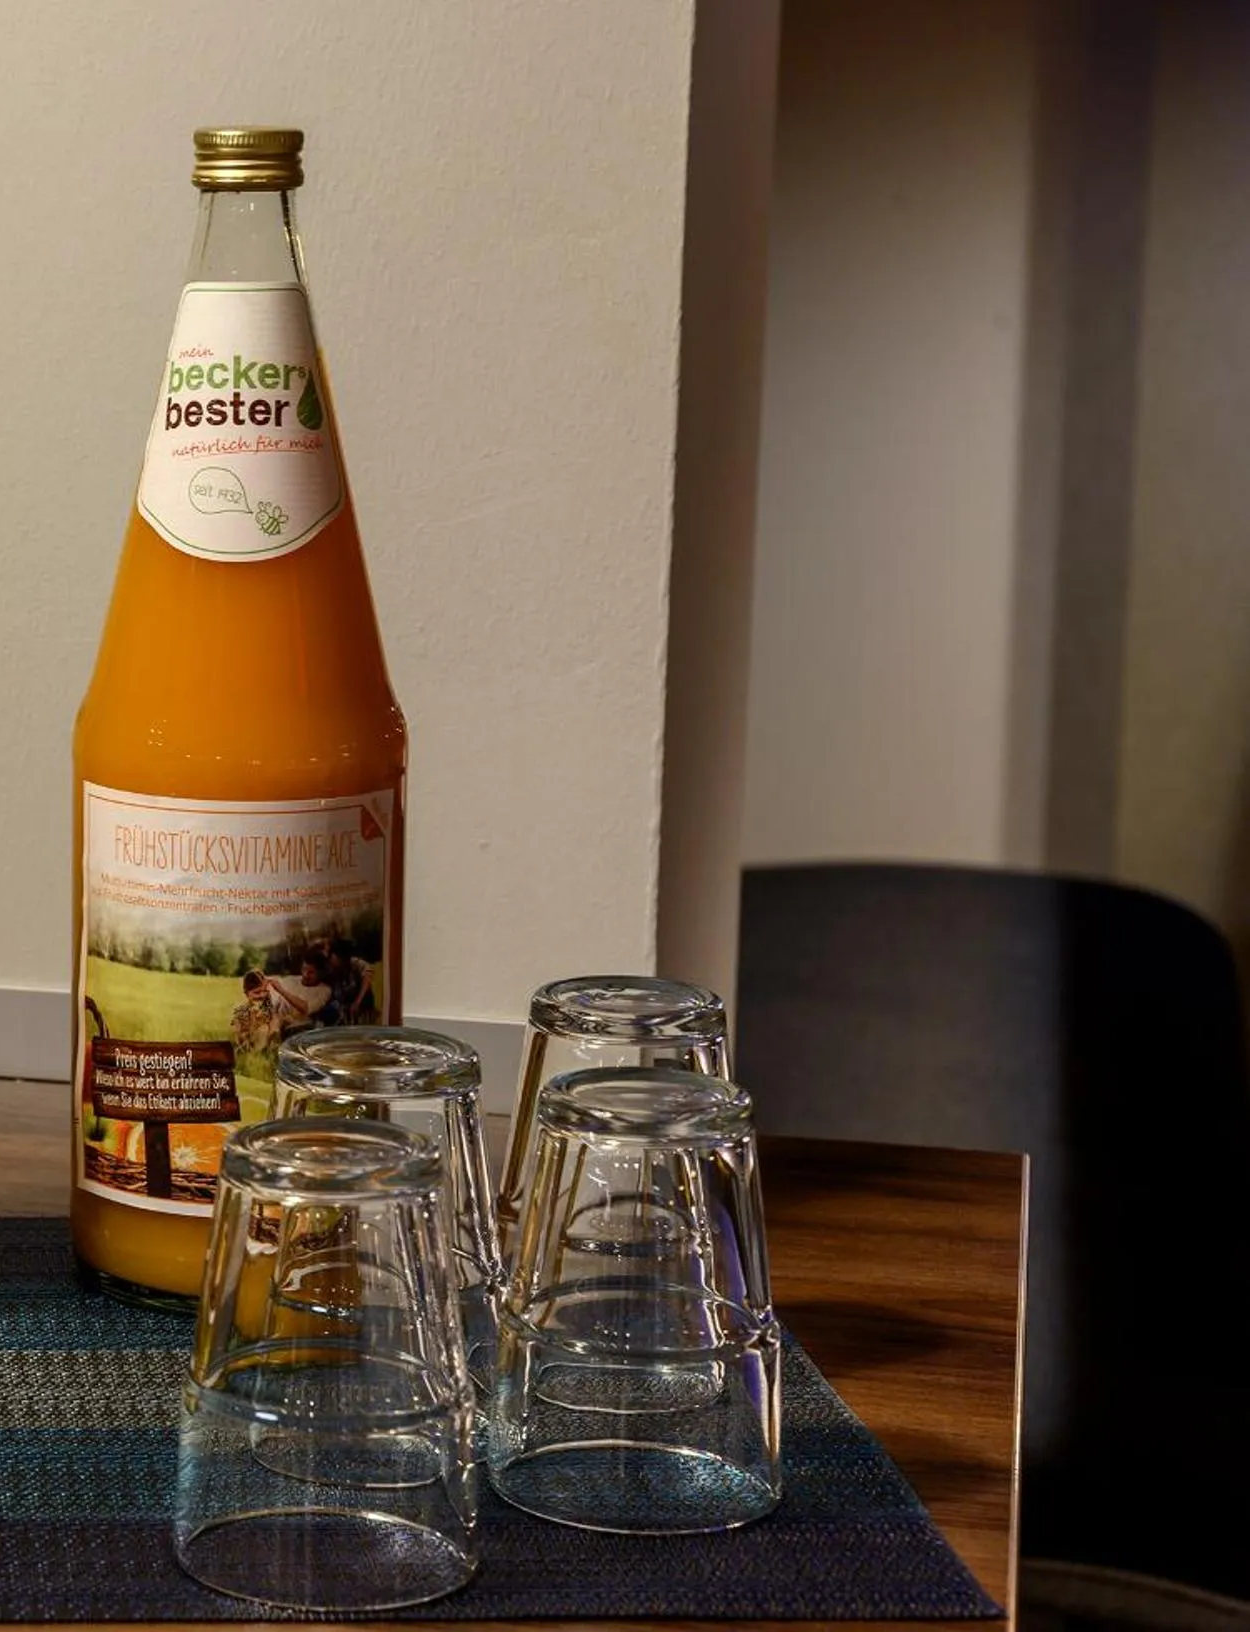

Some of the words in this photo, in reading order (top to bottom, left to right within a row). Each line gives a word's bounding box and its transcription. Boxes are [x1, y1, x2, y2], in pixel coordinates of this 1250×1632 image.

[178, 344, 214, 359] mein
[165, 392, 290, 430] bester
[171, 435, 250, 458] natürlich
[253, 435, 283, 454] für
[114, 824, 323, 874] FRÜHSTÜCKSVITAMINE
[327, 830, 359, 869] ACE
[114, 1047, 137, 1067] Preis
[139, 1049, 193, 1077] gestiegen?
[135, 1075, 155, 1090] wert
[156, 1073, 169, 1090] bin
[171, 1073, 212, 1090] erfahren
[133, 1092, 147, 1109] das
[148, 1092, 178, 1110] Etikett
[178, 1092, 222, 1110] abziehen!
